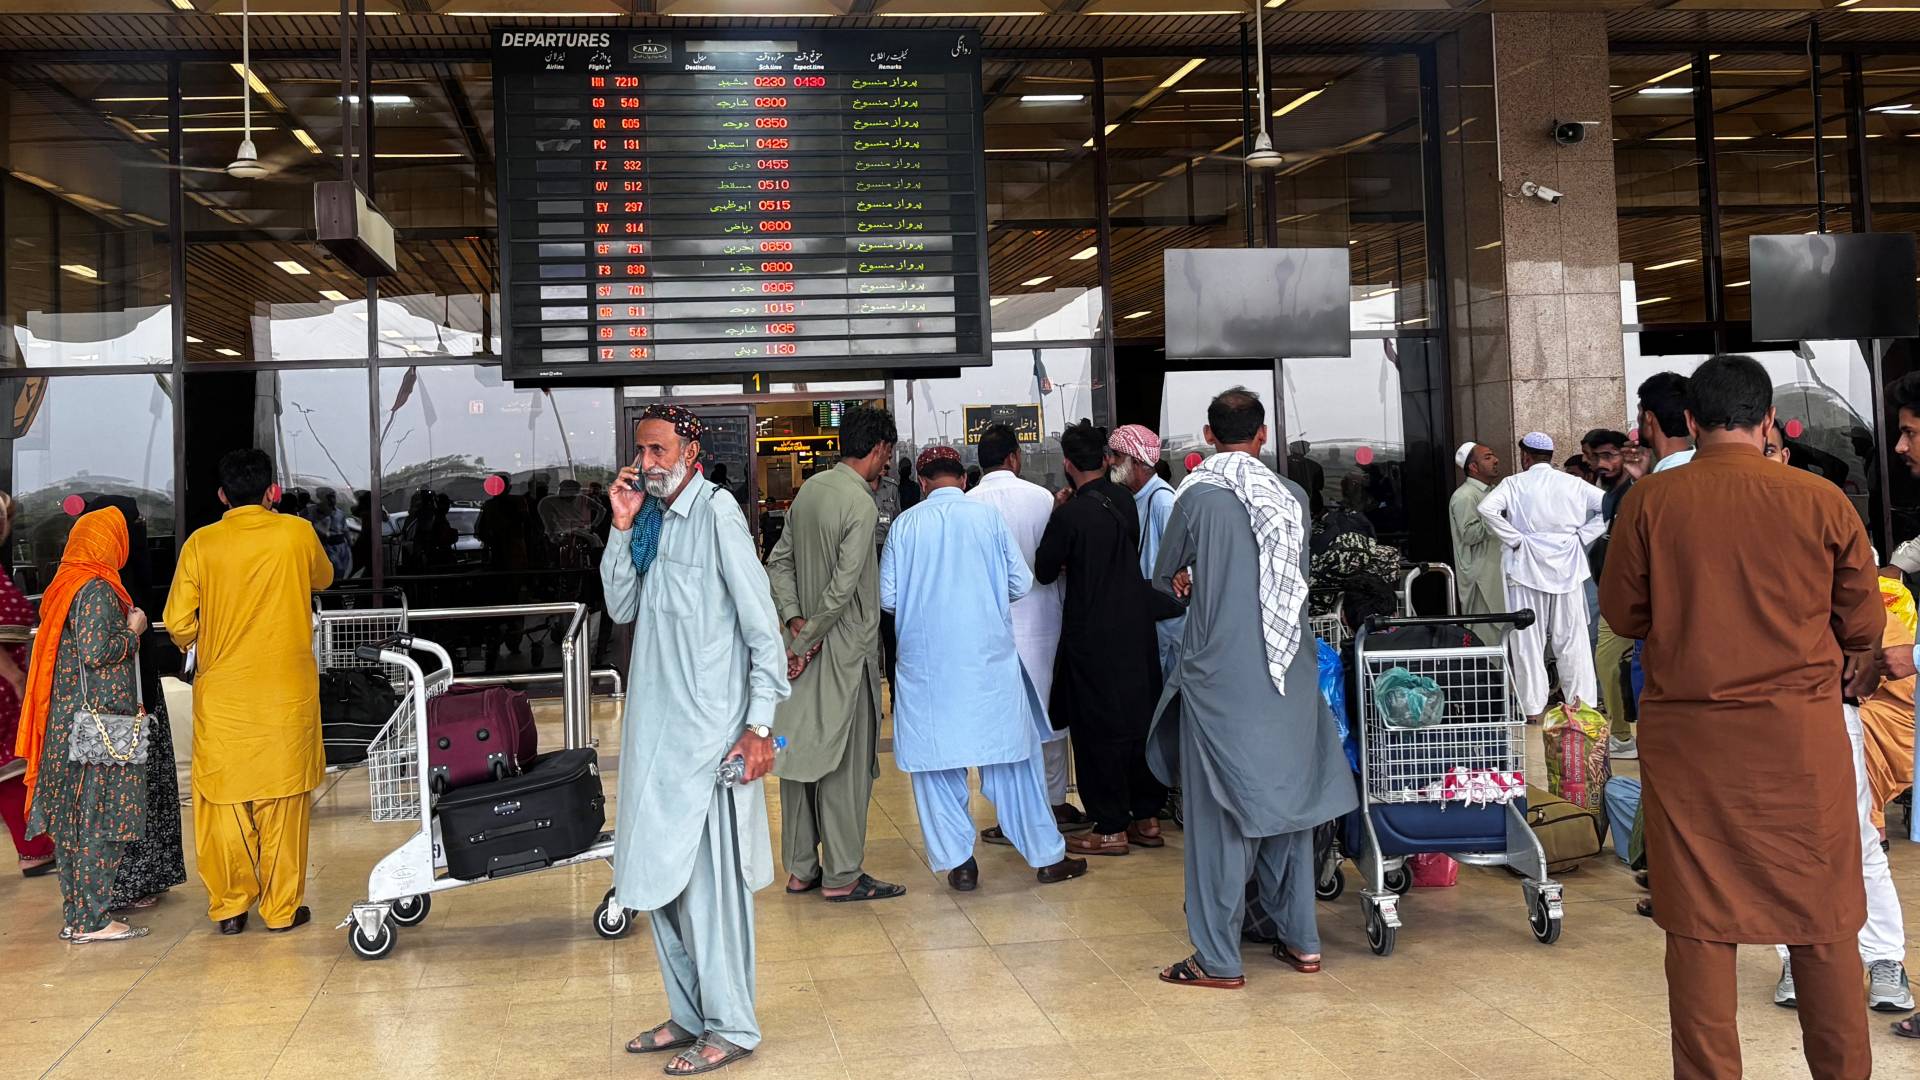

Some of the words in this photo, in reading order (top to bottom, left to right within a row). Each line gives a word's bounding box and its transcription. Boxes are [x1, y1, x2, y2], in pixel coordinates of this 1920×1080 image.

[501, 32, 610, 47] DEPARTURES
[951, 35, 972, 57] روانگی
[615, 77, 639, 87] 7210
[753, 76, 786, 87] 0230
[793, 76, 826, 87] 0430
[852, 79, 888, 89] منسوخ
[889, 76, 918, 87] پرواز
[592, 98, 605, 108] G9
[621, 98, 639, 108] 549
[754, 97, 787, 107] 0300
[852, 99, 889, 109] منسوخ
[889, 97, 919, 108] پرواز
[593, 119, 606, 129] OR
[622, 119, 640, 129] 605
[755, 118, 788, 128] 0350
[853, 120, 889, 129] منسوخ
[890, 116, 919, 128] پرواز
[594, 140, 607, 150] PC
[624, 140, 640, 150] 131
[756, 138, 788, 149] 0425
[854, 140, 890, 150] منسوخ
[891, 137, 920, 148] پرواز
[595, 161, 607, 171] FZ
[624, 161, 641, 170] 332
[757, 159, 789, 169] 0455
[855, 161, 891, 170] منسوخ
[892, 158, 921, 169] پرواز
[595, 181, 608, 191] OV
[624, 181, 642, 191] 512
[758, 180, 790, 190] 0510
[856, 181, 891, 191] منسوخ
[893, 178, 921, 189] پرواز
[596, 202, 608, 212] EY
[625, 202, 643, 212] 297
[758, 200, 791, 210] 0515
[856, 201, 893, 211] منسوخ
[893, 198, 922, 209] پرواز
[597, 223, 609, 233] XY
[625, 223, 643, 233] 314
[725, 221, 754, 233] ریاض
[759, 221, 792, 231] 0600
[857, 221, 893, 232] منسوخ
[894, 219, 923, 230] پرواز
[598, 244, 610, 254] GF
[626, 244, 643, 254] 751
[723, 244, 754, 254] بحرین
[760, 241, 792, 252] 0650
[858, 242, 894, 252] منسوخ
[895, 240, 924, 250] پرواز
[598, 265, 611, 275] F3
[761, 261, 793, 272] 0800
[859, 262, 895, 272] منسوخ
[896, 259, 925, 271] پرواز
[761, 282, 794, 292] 0905
[860, 283, 896, 293] منسوخ
[897, 280, 925, 291] پرواز
[599, 286, 611, 296] SV
[627, 286, 645, 296] 701
[764, 303, 795, 313] 1015
[861, 303, 897, 313] منسوخ
[897, 300, 926, 311] پرواز
[628, 307, 645, 317] 611
[629, 327, 647, 337] 543
[765, 323, 795, 333] 1035
[601, 348, 614, 359] FZ
[629, 348, 648, 358] 334
[766, 344, 796, 354] 1130
[752, 373, 760, 391] 1
[1018, 432, 1037, 441] GATE
